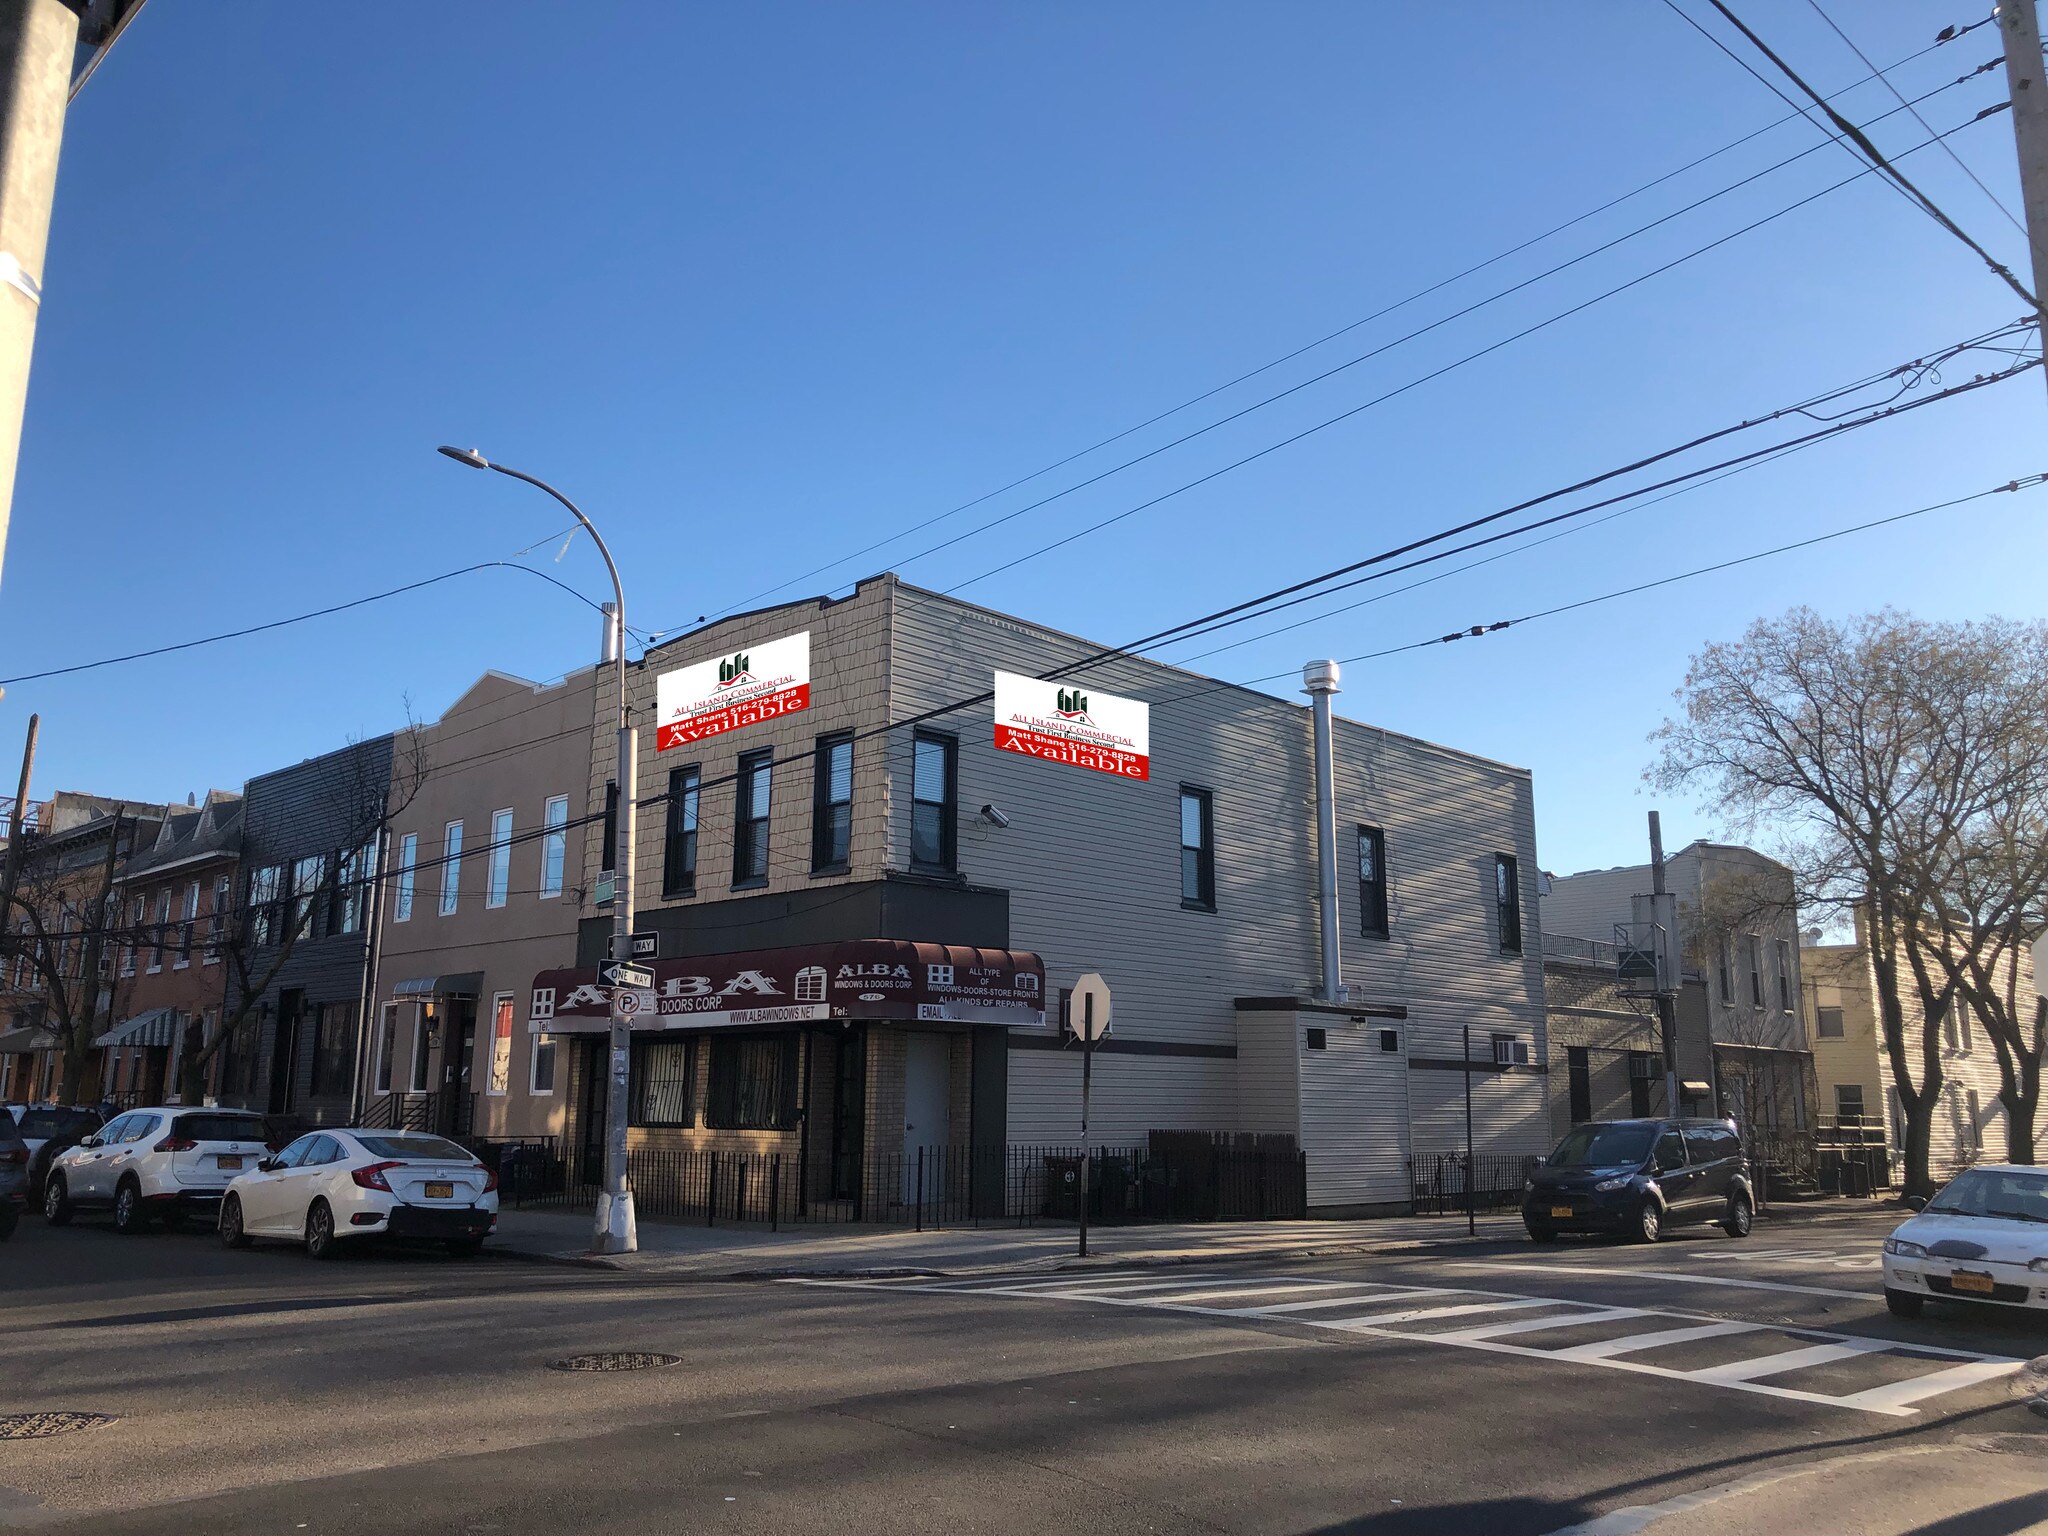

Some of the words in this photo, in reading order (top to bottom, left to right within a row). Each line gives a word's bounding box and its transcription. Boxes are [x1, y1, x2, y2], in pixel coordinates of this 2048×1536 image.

[674, 706, 690, 716] ALL
[694, 694, 729, 709] ISLAND
[730, 674, 795, 698] COMMERCIAL
[690, 707, 708, 718] Trust
[709, 703, 724, 712] First
[726, 695, 752, 708] Business
[753, 687, 776, 699] Second
[671, 722, 693, 732] Matt
[696, 711, 727, 724] Shane
[730, 689, 797, 715] 516-279-8828
[664, 698, 802, 748] Available
[1011, 713, 1027, 723] ALL
[1031, 716, 1067, 731] ISLAND
[1069, 725, 1134, 746] COMMERCIAL
[1008, 729, 1031, 739] Matt
[1034, 734, 1066, 747] Shane
[1068, 741, 1136, 763] 516-279-8828
[1028, 725, 1046, 734] Trust
[1047, 729, 1062, 738] First
[1064, 733, 1091, 744] Business
[1092, 738, 1115, 749] Second
[1002, 737, 1142, 777] Available
[635, 940, 652, 951] WAY
[611, 968, 628, 981] ONE
[634, 974, 649, 985] WAY
[836, 963, 912, 979] ALBA
[969, 967, 982, 976] ALL
[984, 968, 1000, 977] TYPE
[834, 980, 863, 989] WINDOWS
[870, 980, 894, 988] DOORS
[895, 980, 913, 989] CORP.
[983, 998, 993, 1007] OF
[995, 999, 1028, 1008] REPAIRS
[1013, 989, 1039, 999] FRONTS
[661, 998, 693, 1014] DOORS
[695, 995, 723, 1011] CORP.
[832, 1006, 848, 1016] Tel:
[729, 1006, 815, 1024] WWW.ALBAWINDOWS.NET
